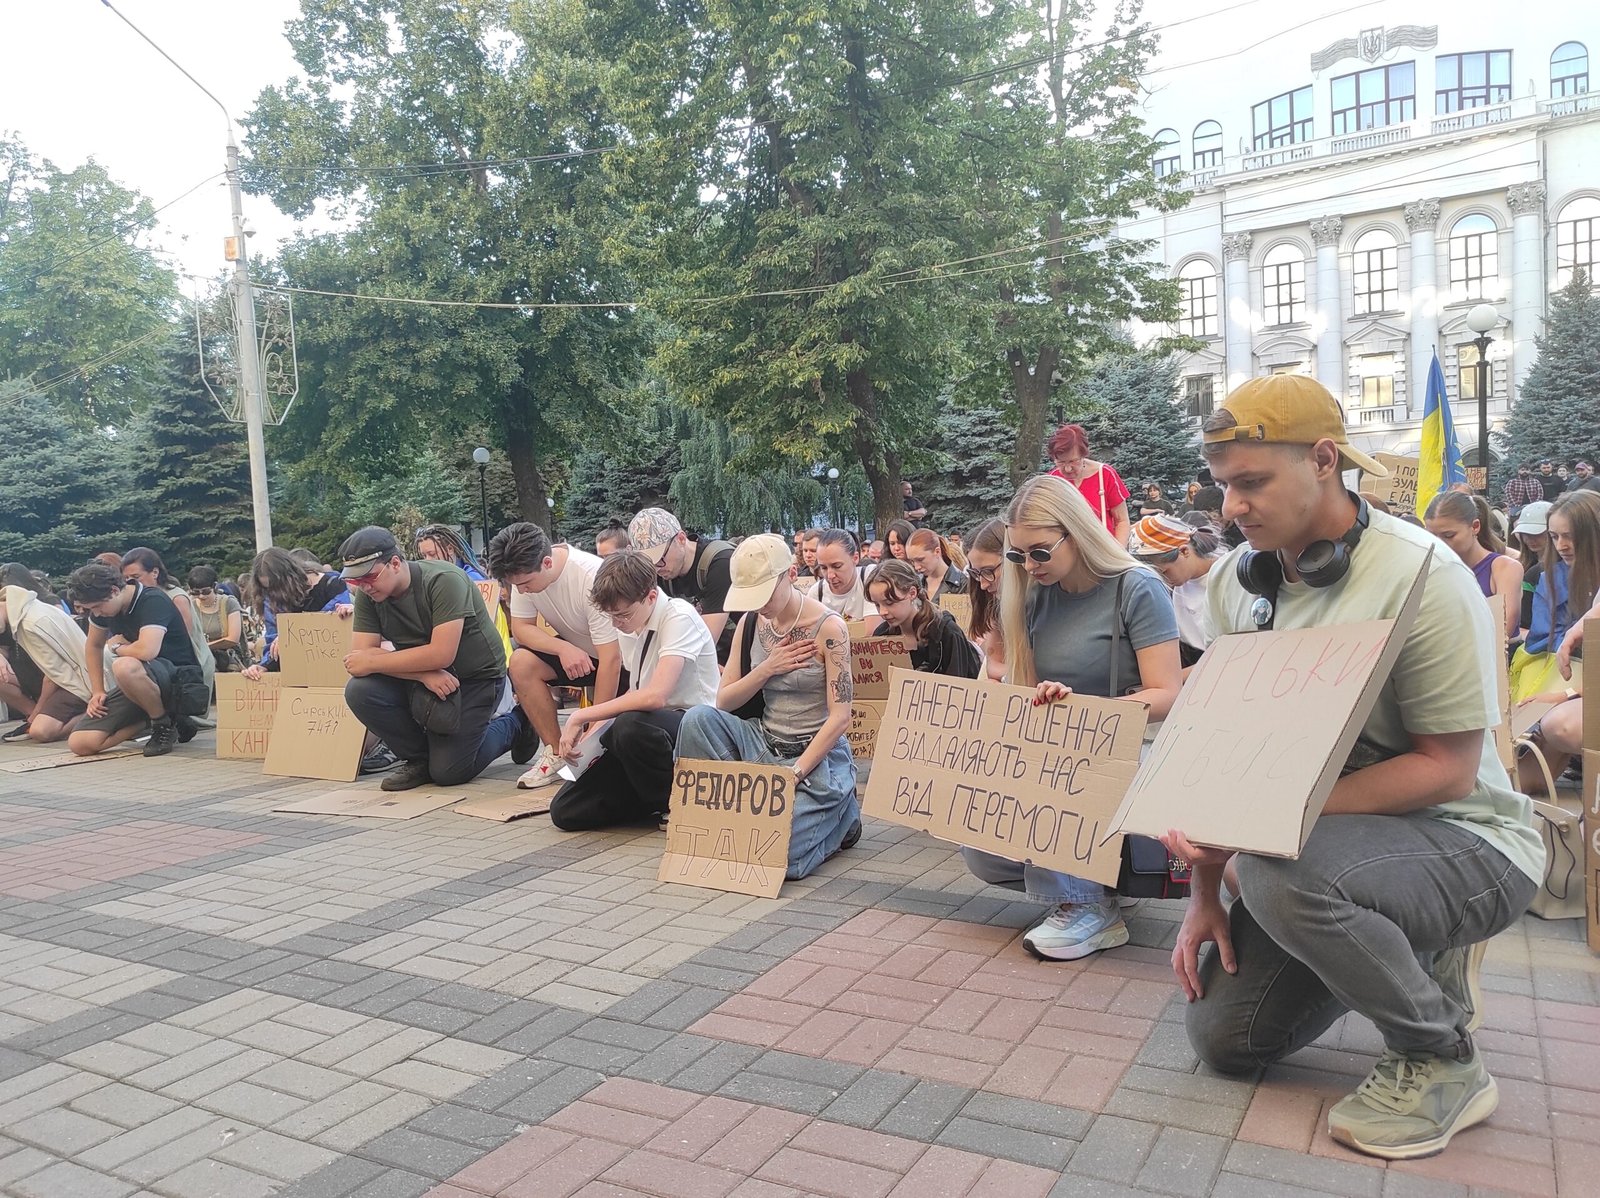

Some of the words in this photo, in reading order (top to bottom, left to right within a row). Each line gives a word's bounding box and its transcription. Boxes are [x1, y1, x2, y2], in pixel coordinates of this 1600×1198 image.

[231, 728, 269, 753] КАНІ
[897, 679, 988, 731] ГАНЕБНІ
[1001, 694, 1121, 756] РІШЕННЯ
[675, 769, 787, 817] ФЕДОРОВ
[891, 727, 1027, 779] ВІДДАЛЯЮТЬ
[1038, 750, 1090, 796] НАС
[892, 776, 934, 822] ВІД
[946, 783, 1099, 865] ПЕРЕМОГИ
[675, 824, 782, 888] ТАК
